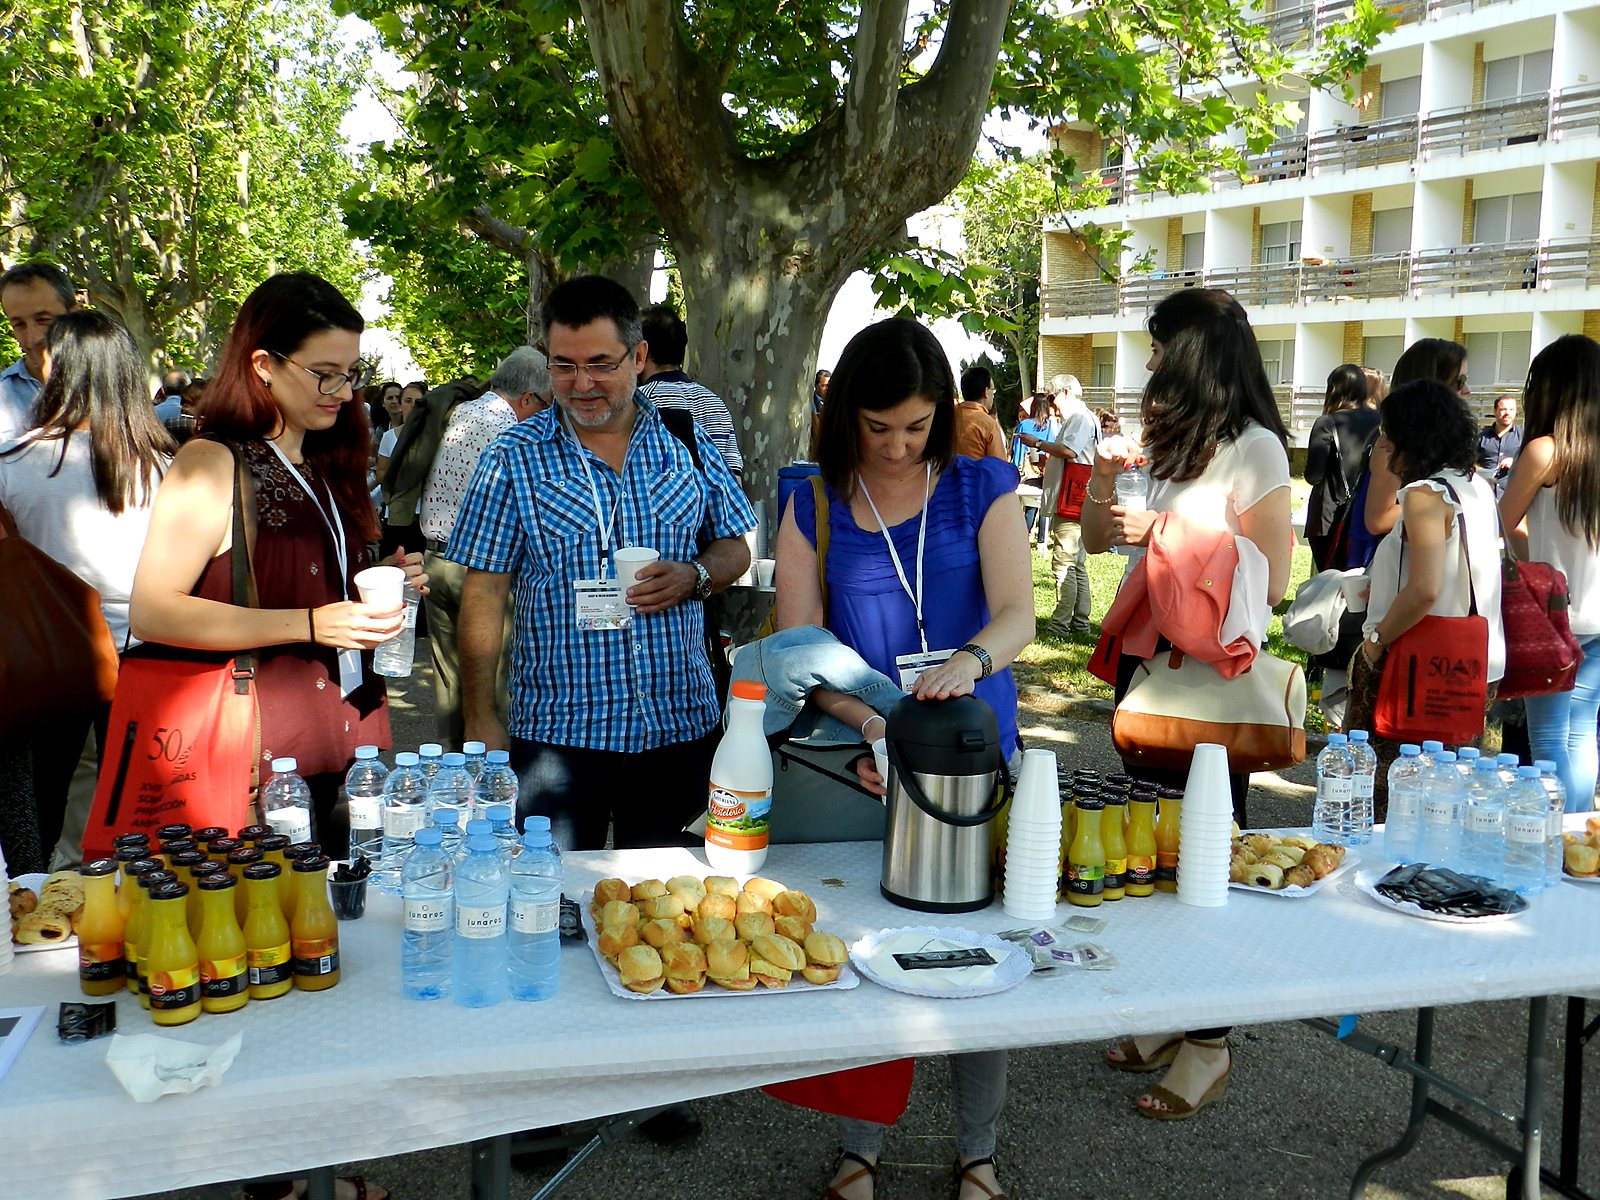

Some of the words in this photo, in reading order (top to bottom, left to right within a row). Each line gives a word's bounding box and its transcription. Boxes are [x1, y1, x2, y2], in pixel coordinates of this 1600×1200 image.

[1428, 656, 1450, 678] 50
[147, 727, 183, 762] 50
[409, 911, 444, 919] lunares
[467, 917, 502, 927] lunares
